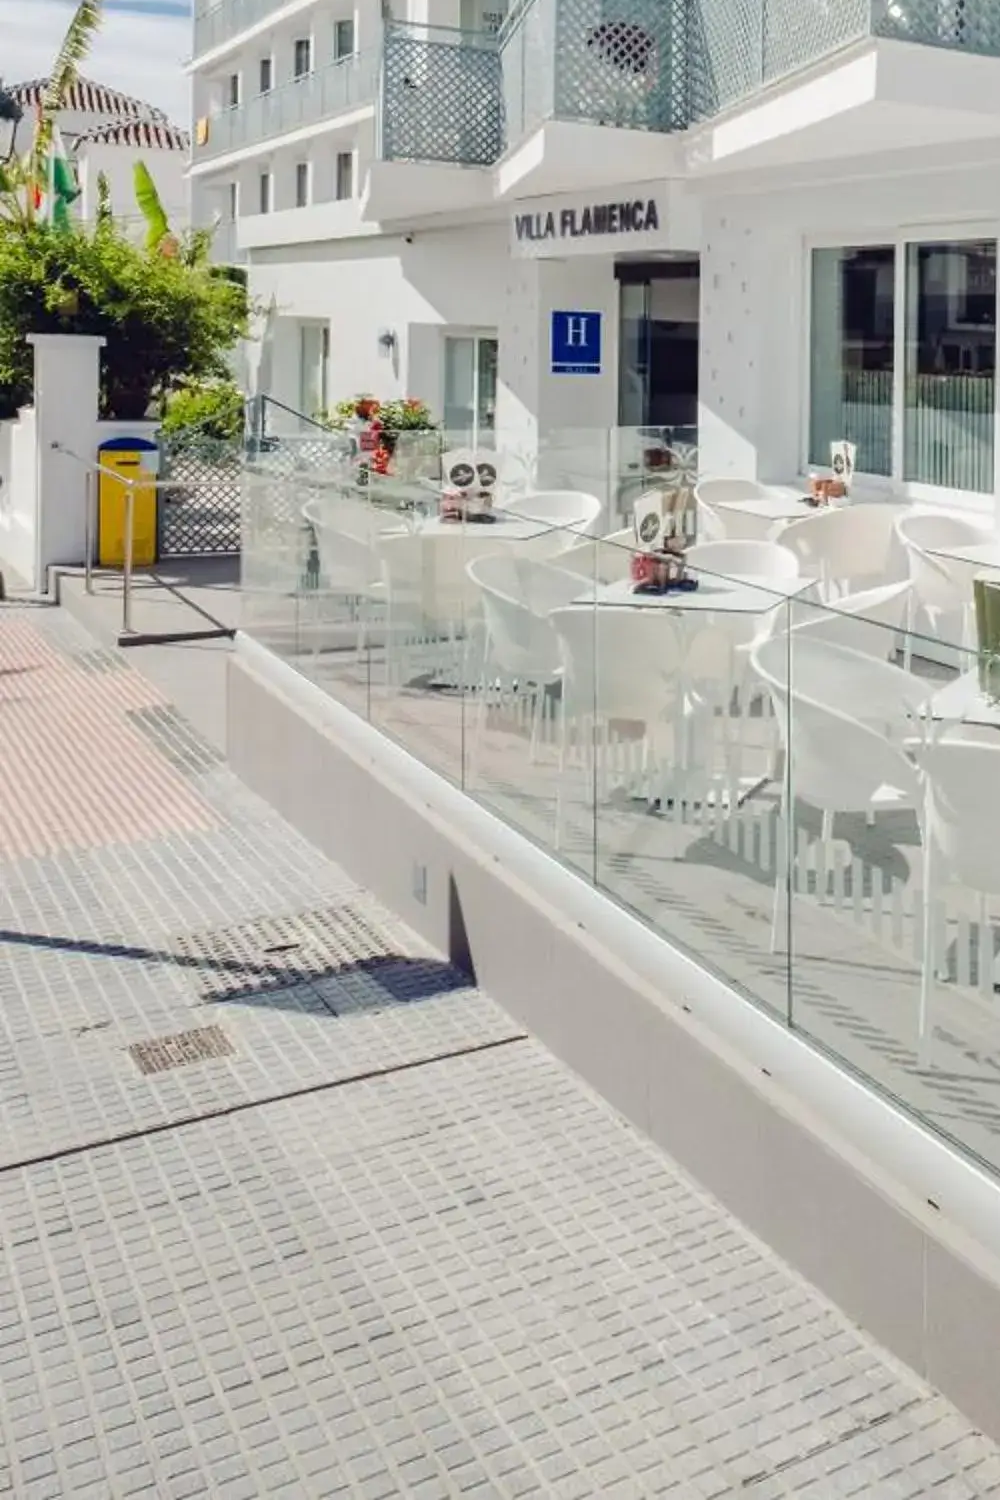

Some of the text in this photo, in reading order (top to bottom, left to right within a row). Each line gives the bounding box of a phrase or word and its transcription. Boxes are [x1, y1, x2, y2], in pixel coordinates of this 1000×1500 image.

[515, 199, 659, 241] VILLA FLAMENCA
[565, 315, 589, 347] H
